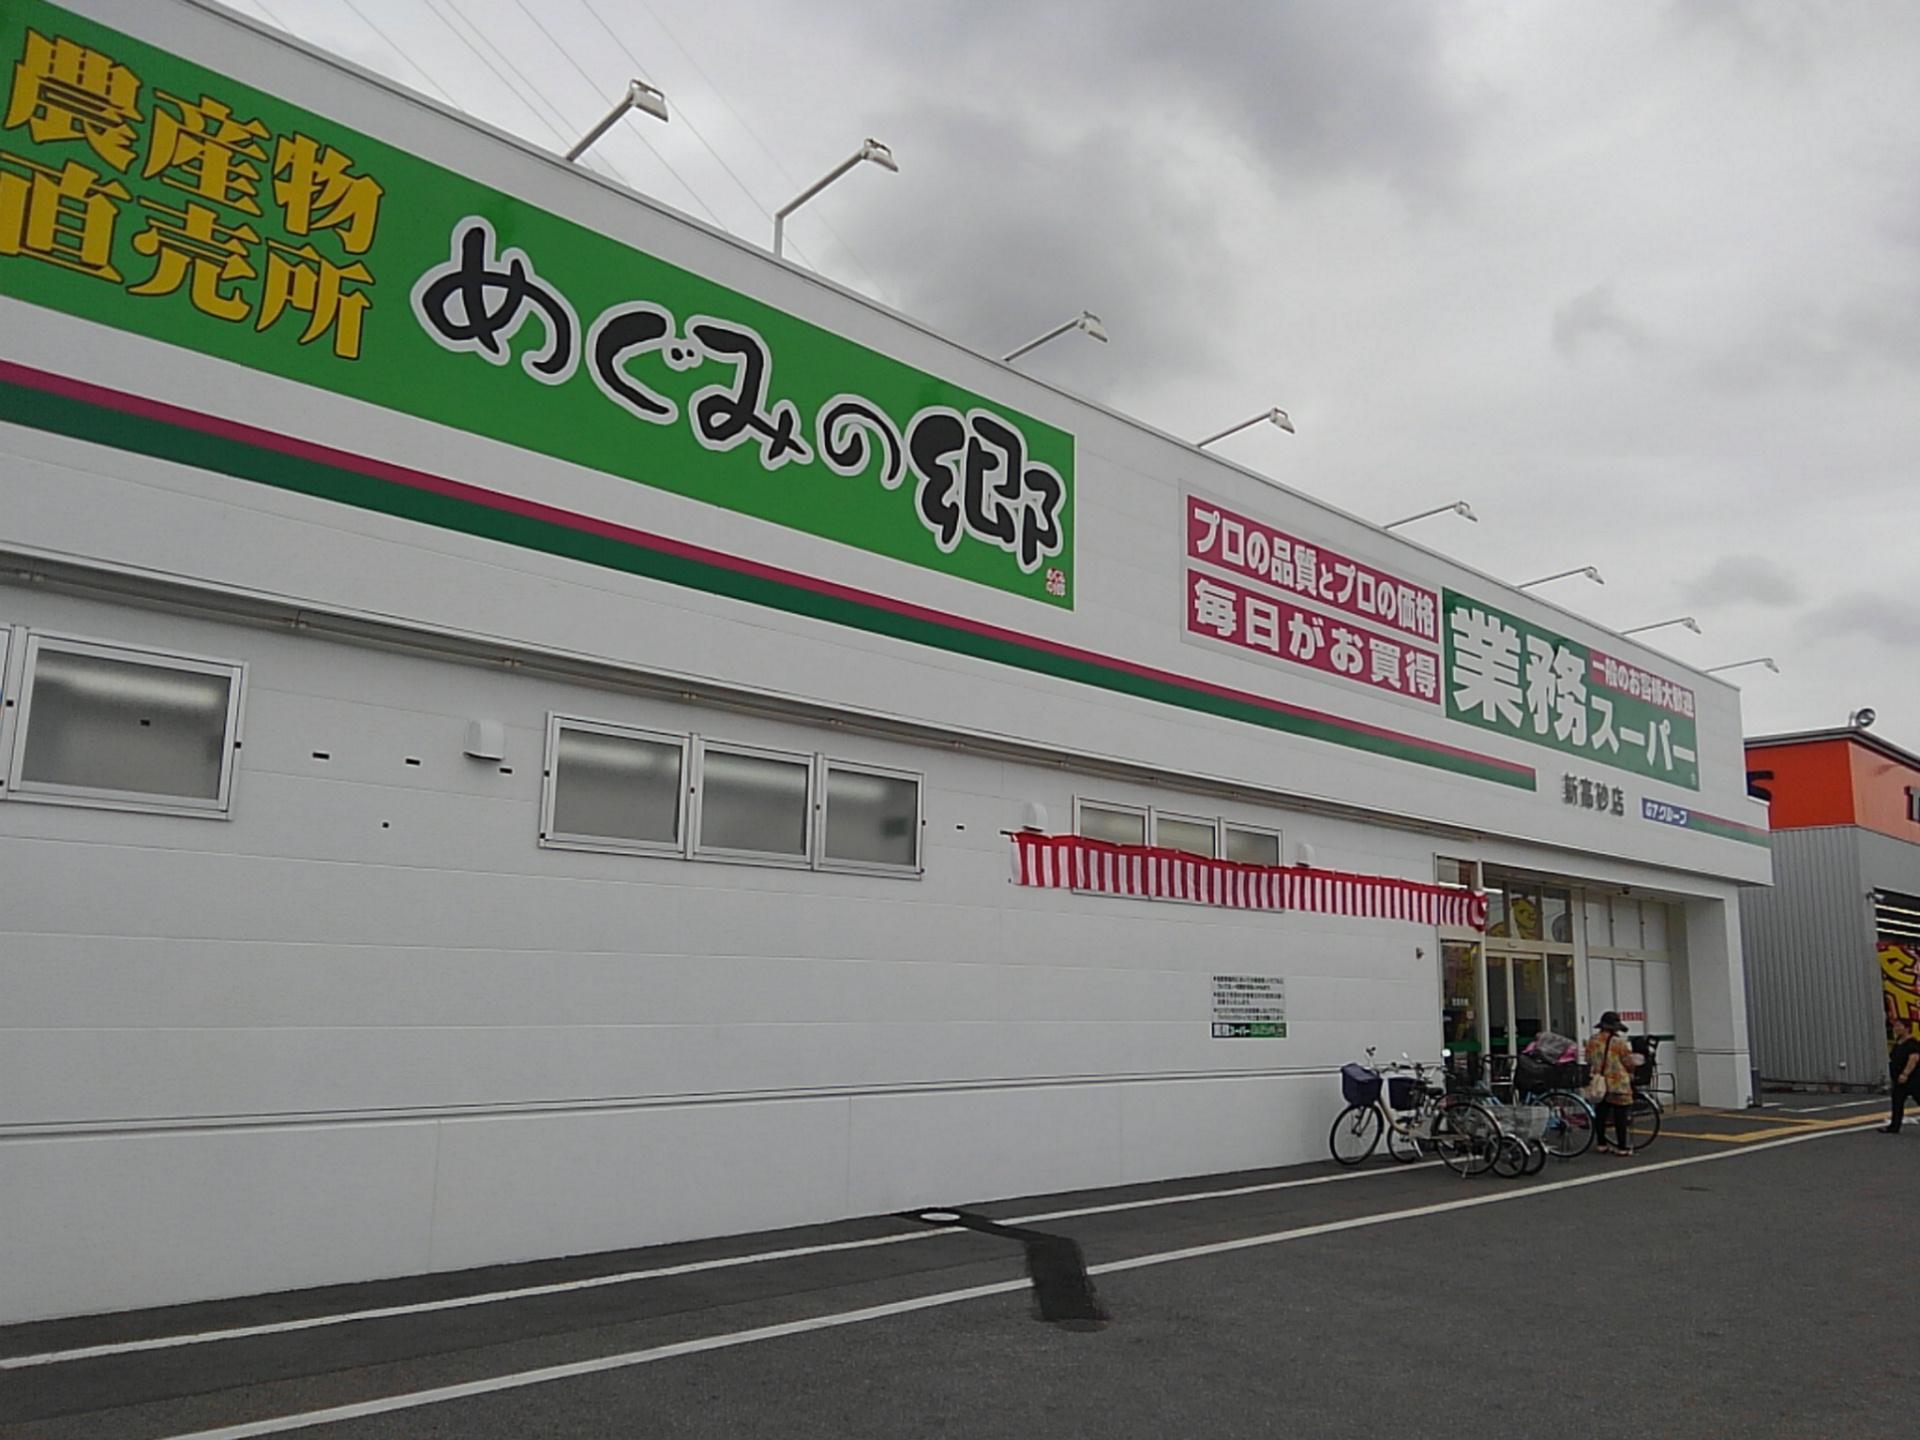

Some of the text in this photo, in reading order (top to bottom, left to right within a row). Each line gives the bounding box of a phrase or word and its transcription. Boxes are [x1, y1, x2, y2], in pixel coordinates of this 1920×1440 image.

[5, 28, 384, 254] 農産物
[0, 152, 374, 360] 直売所
[412, 216, 1067, 574] めぐみの郷
[1194, 507, 1435, 638] プロの品質とプロの価格
[1194, 578, 1437, 698] 毎日がお買得
[1451, 607, 1696, 771] 業務スーパー
